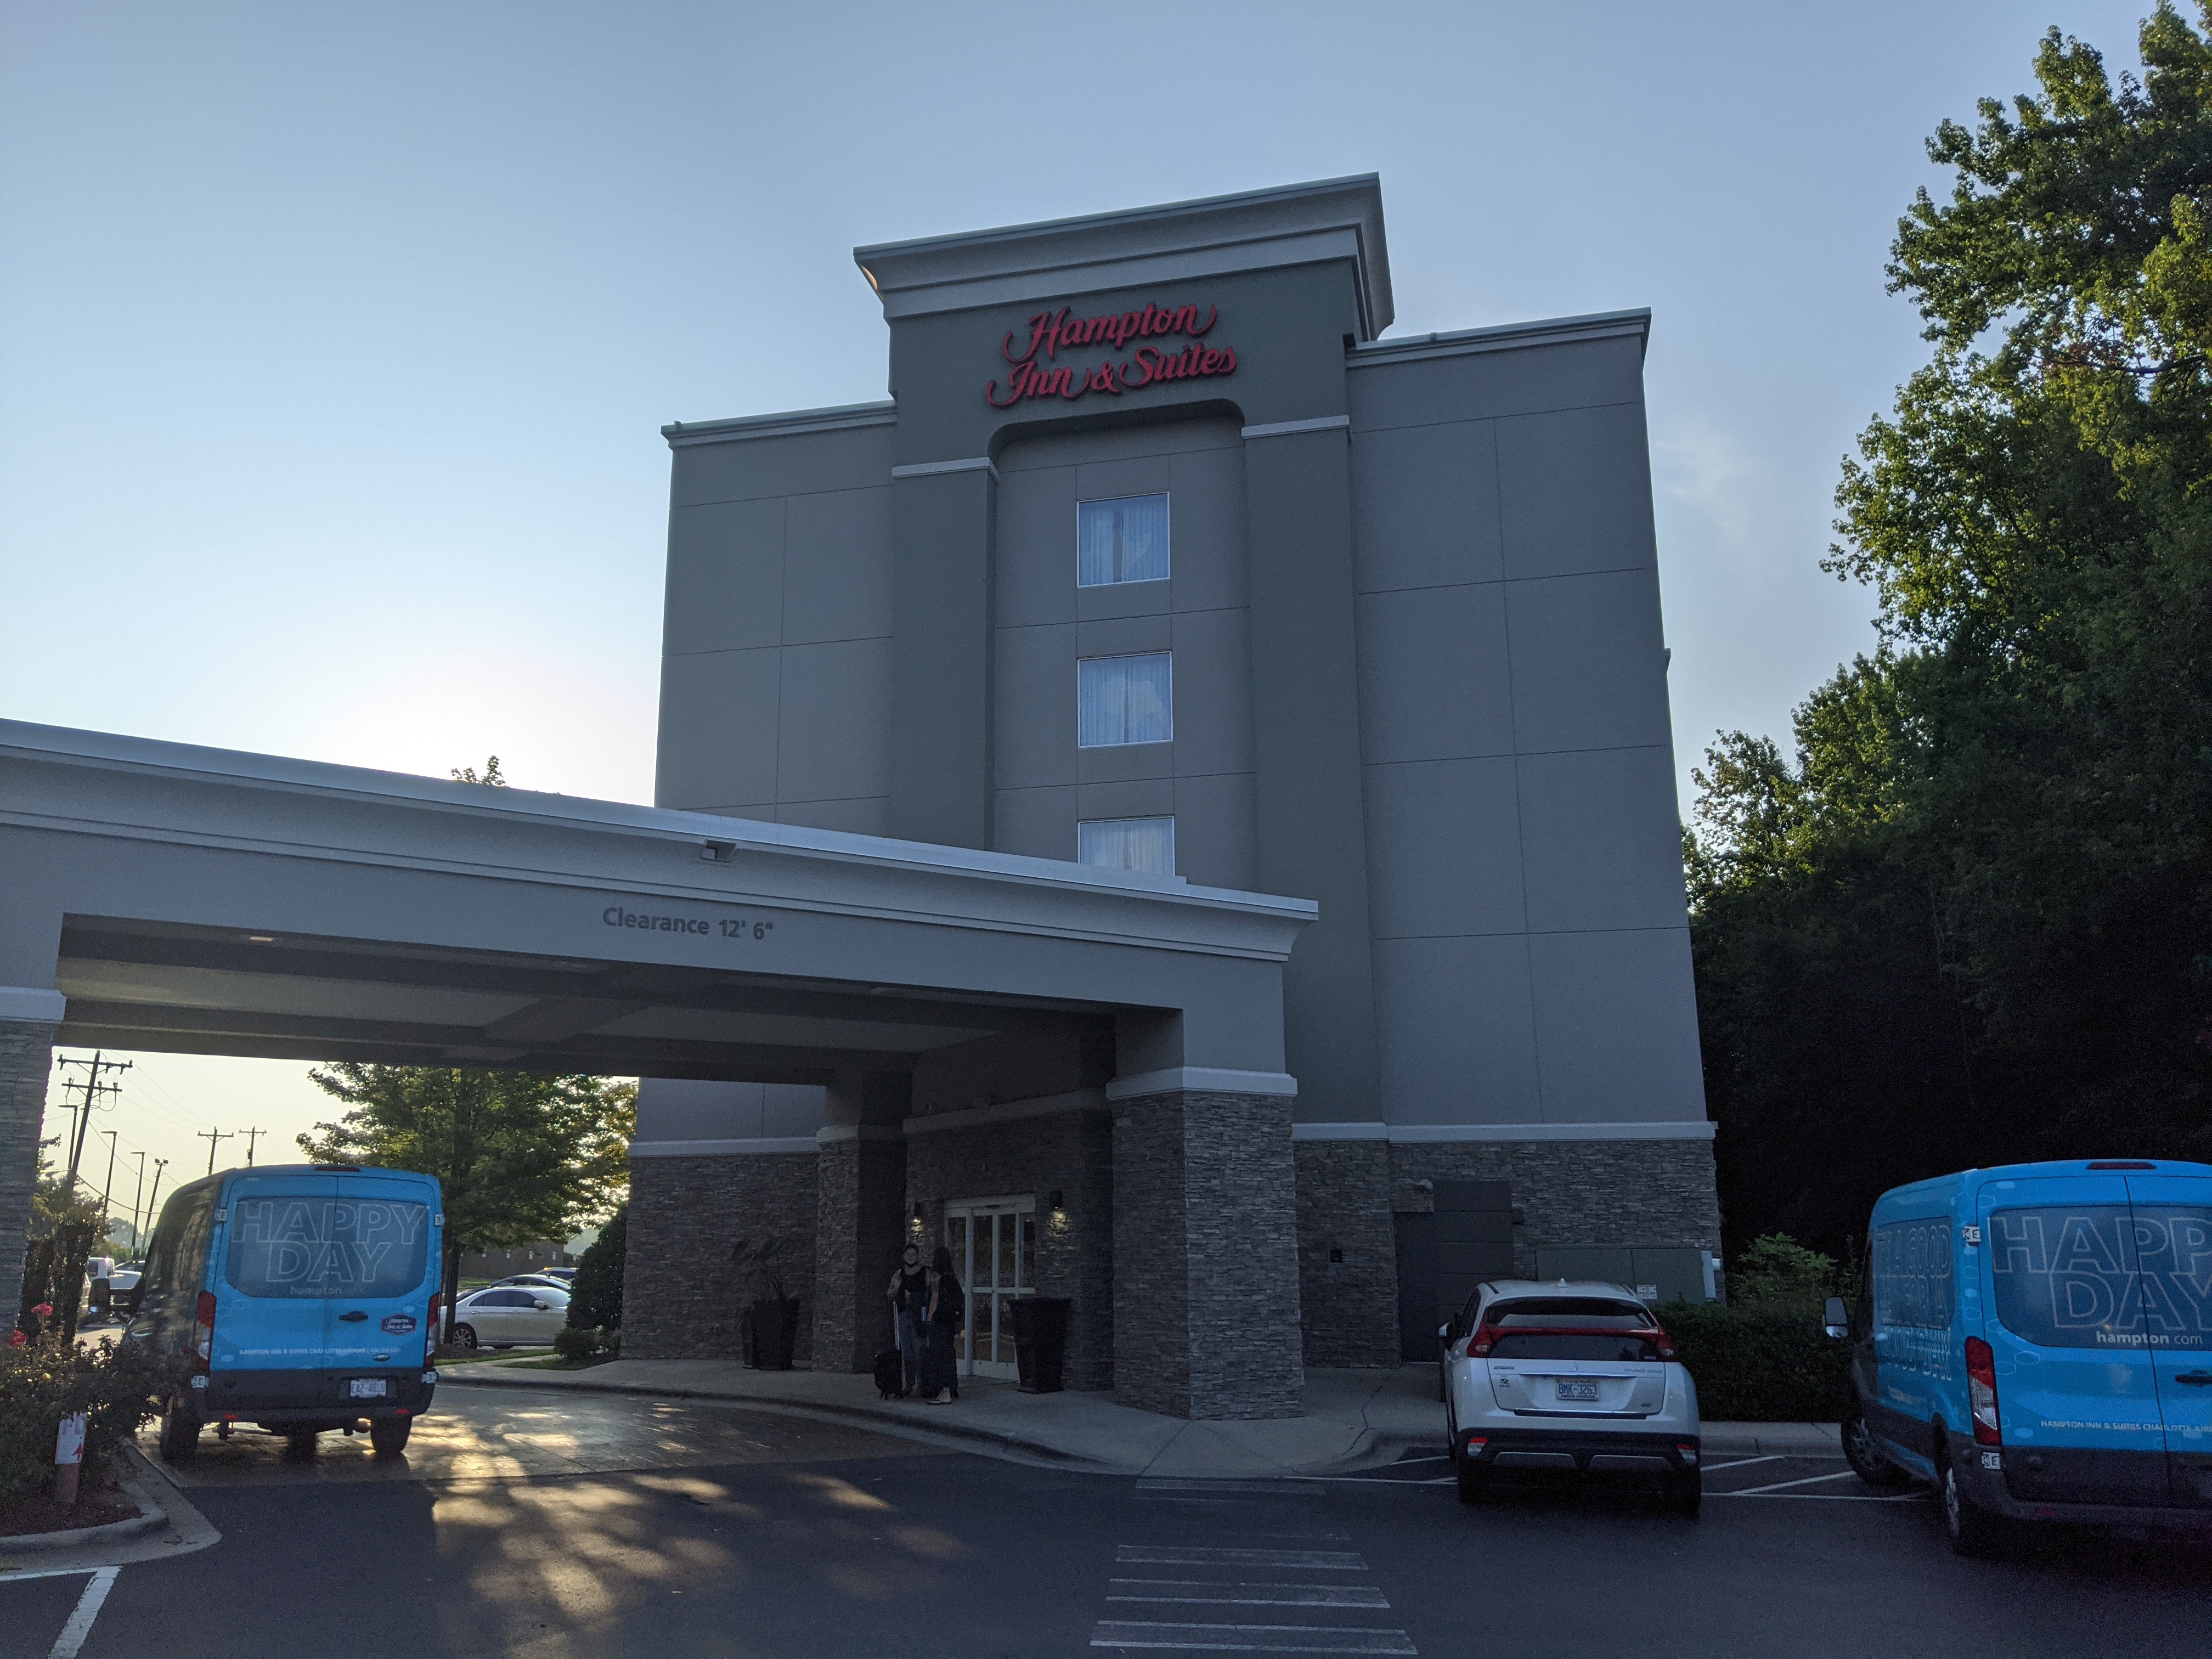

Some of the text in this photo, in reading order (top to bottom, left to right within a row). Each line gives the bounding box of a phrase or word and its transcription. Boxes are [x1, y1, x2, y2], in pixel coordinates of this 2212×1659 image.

[1003, 301, 1217, 363] Hampton
[986, 341, 1238, 407] Inn & Suites
[602, 906, 774, 940] Clearance 12' 6"
[231, 1201, 430, 1245] HAPPY
[265, 1240, 392, 1283] DAY
[2096, 1330, 2202, 1346] hampton.com
[1558, 1383, 1598, 1395] BMK-3263
[2041, 1420, 2084, 1428] HAMPTON
[2113, 1422, 2141, 1430] SUITES
